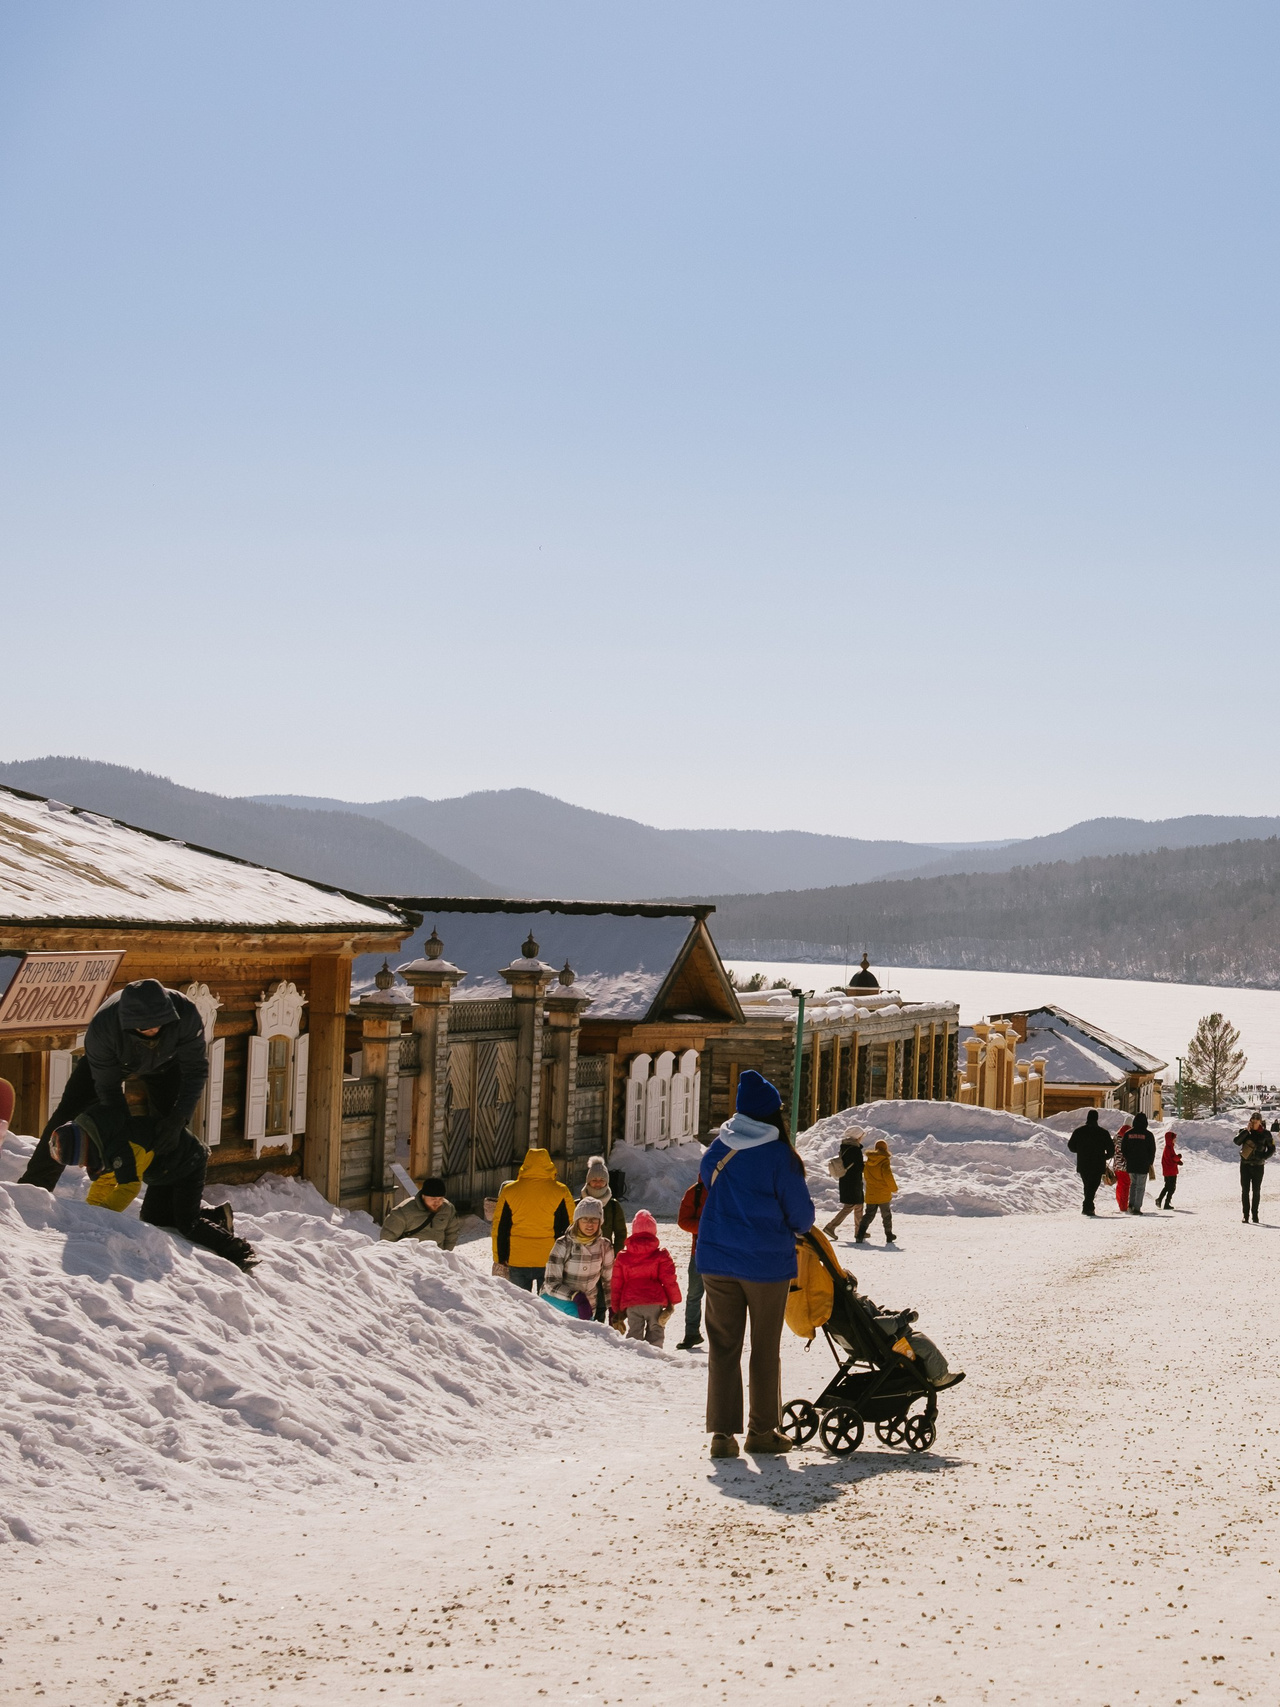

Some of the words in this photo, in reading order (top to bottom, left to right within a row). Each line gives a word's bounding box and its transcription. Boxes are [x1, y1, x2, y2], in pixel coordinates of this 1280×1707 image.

[19, 961, 79, 984] ТОРГОВАЯ
[79, 960, 115, 982] ЛАВКА
[2, 984, 96, 1023] ВОИНОВА
